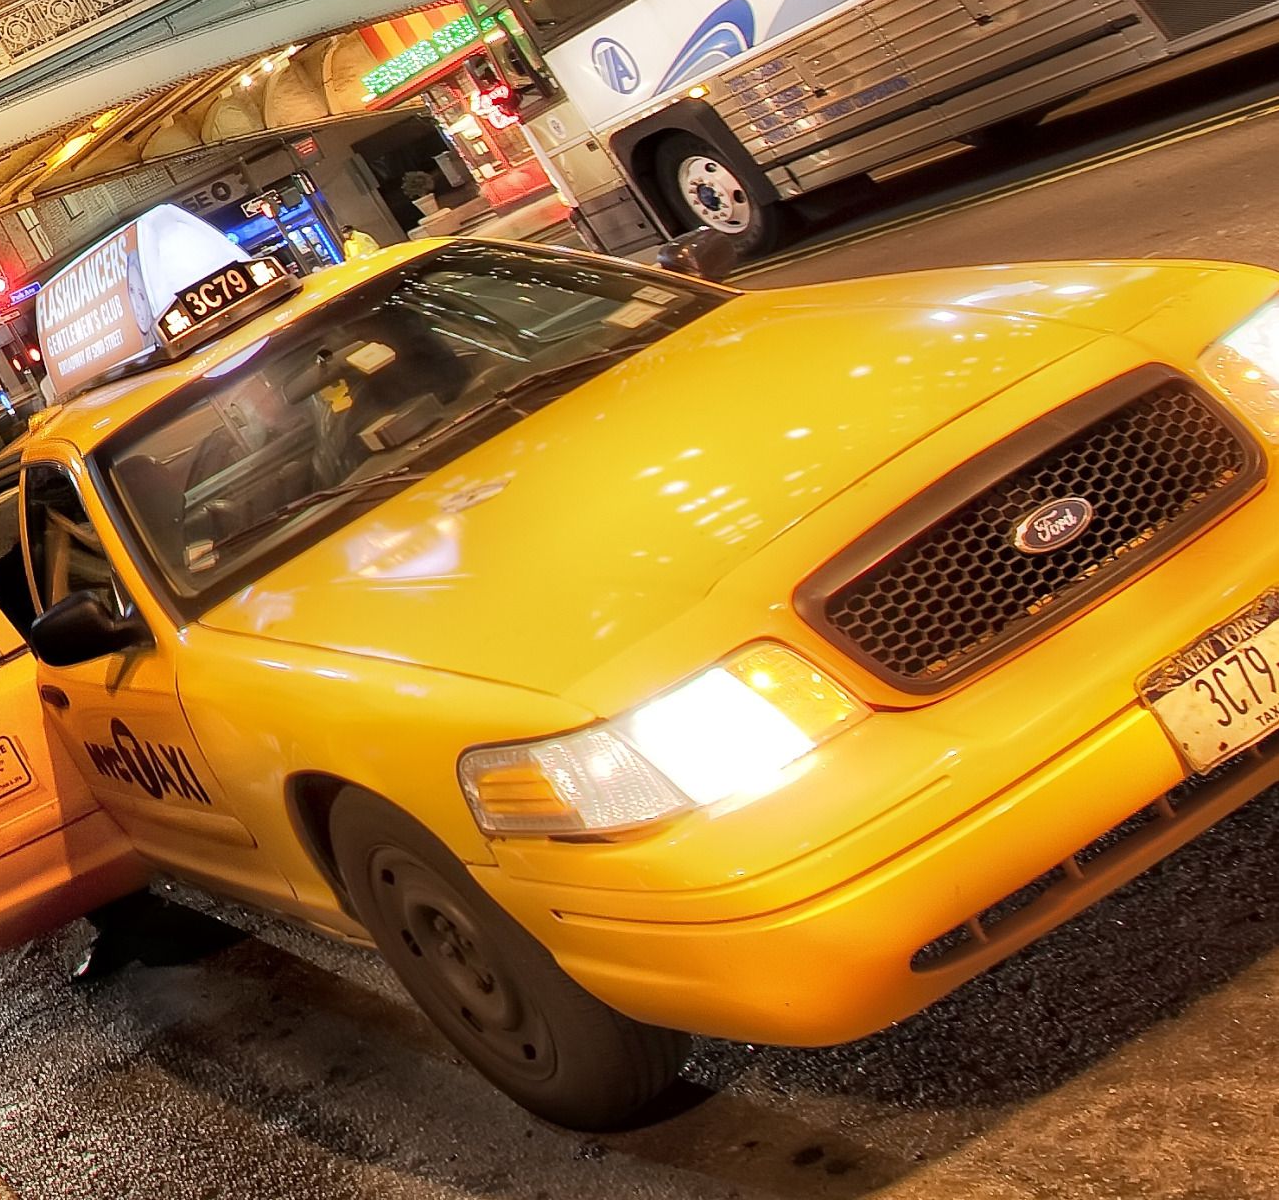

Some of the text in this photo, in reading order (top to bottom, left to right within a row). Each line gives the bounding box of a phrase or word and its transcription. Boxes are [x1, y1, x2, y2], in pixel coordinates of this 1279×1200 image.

[432, 13, 479, 55] SQU
[36, 235, 129, 333] FLASHDANCERS
[185, 269, 248, 316] 3C79
[46, 307, 103, 358] GENTLEMEN'S
[100, 293, 124, 326] CLUB
[1033, 507, 1079, 543] Ford
[1176, 615, 1268, 679] NEW YORK
[1194, 646, 1279, 727] 3C79
[1254, 701, 1279, 726] TAX
